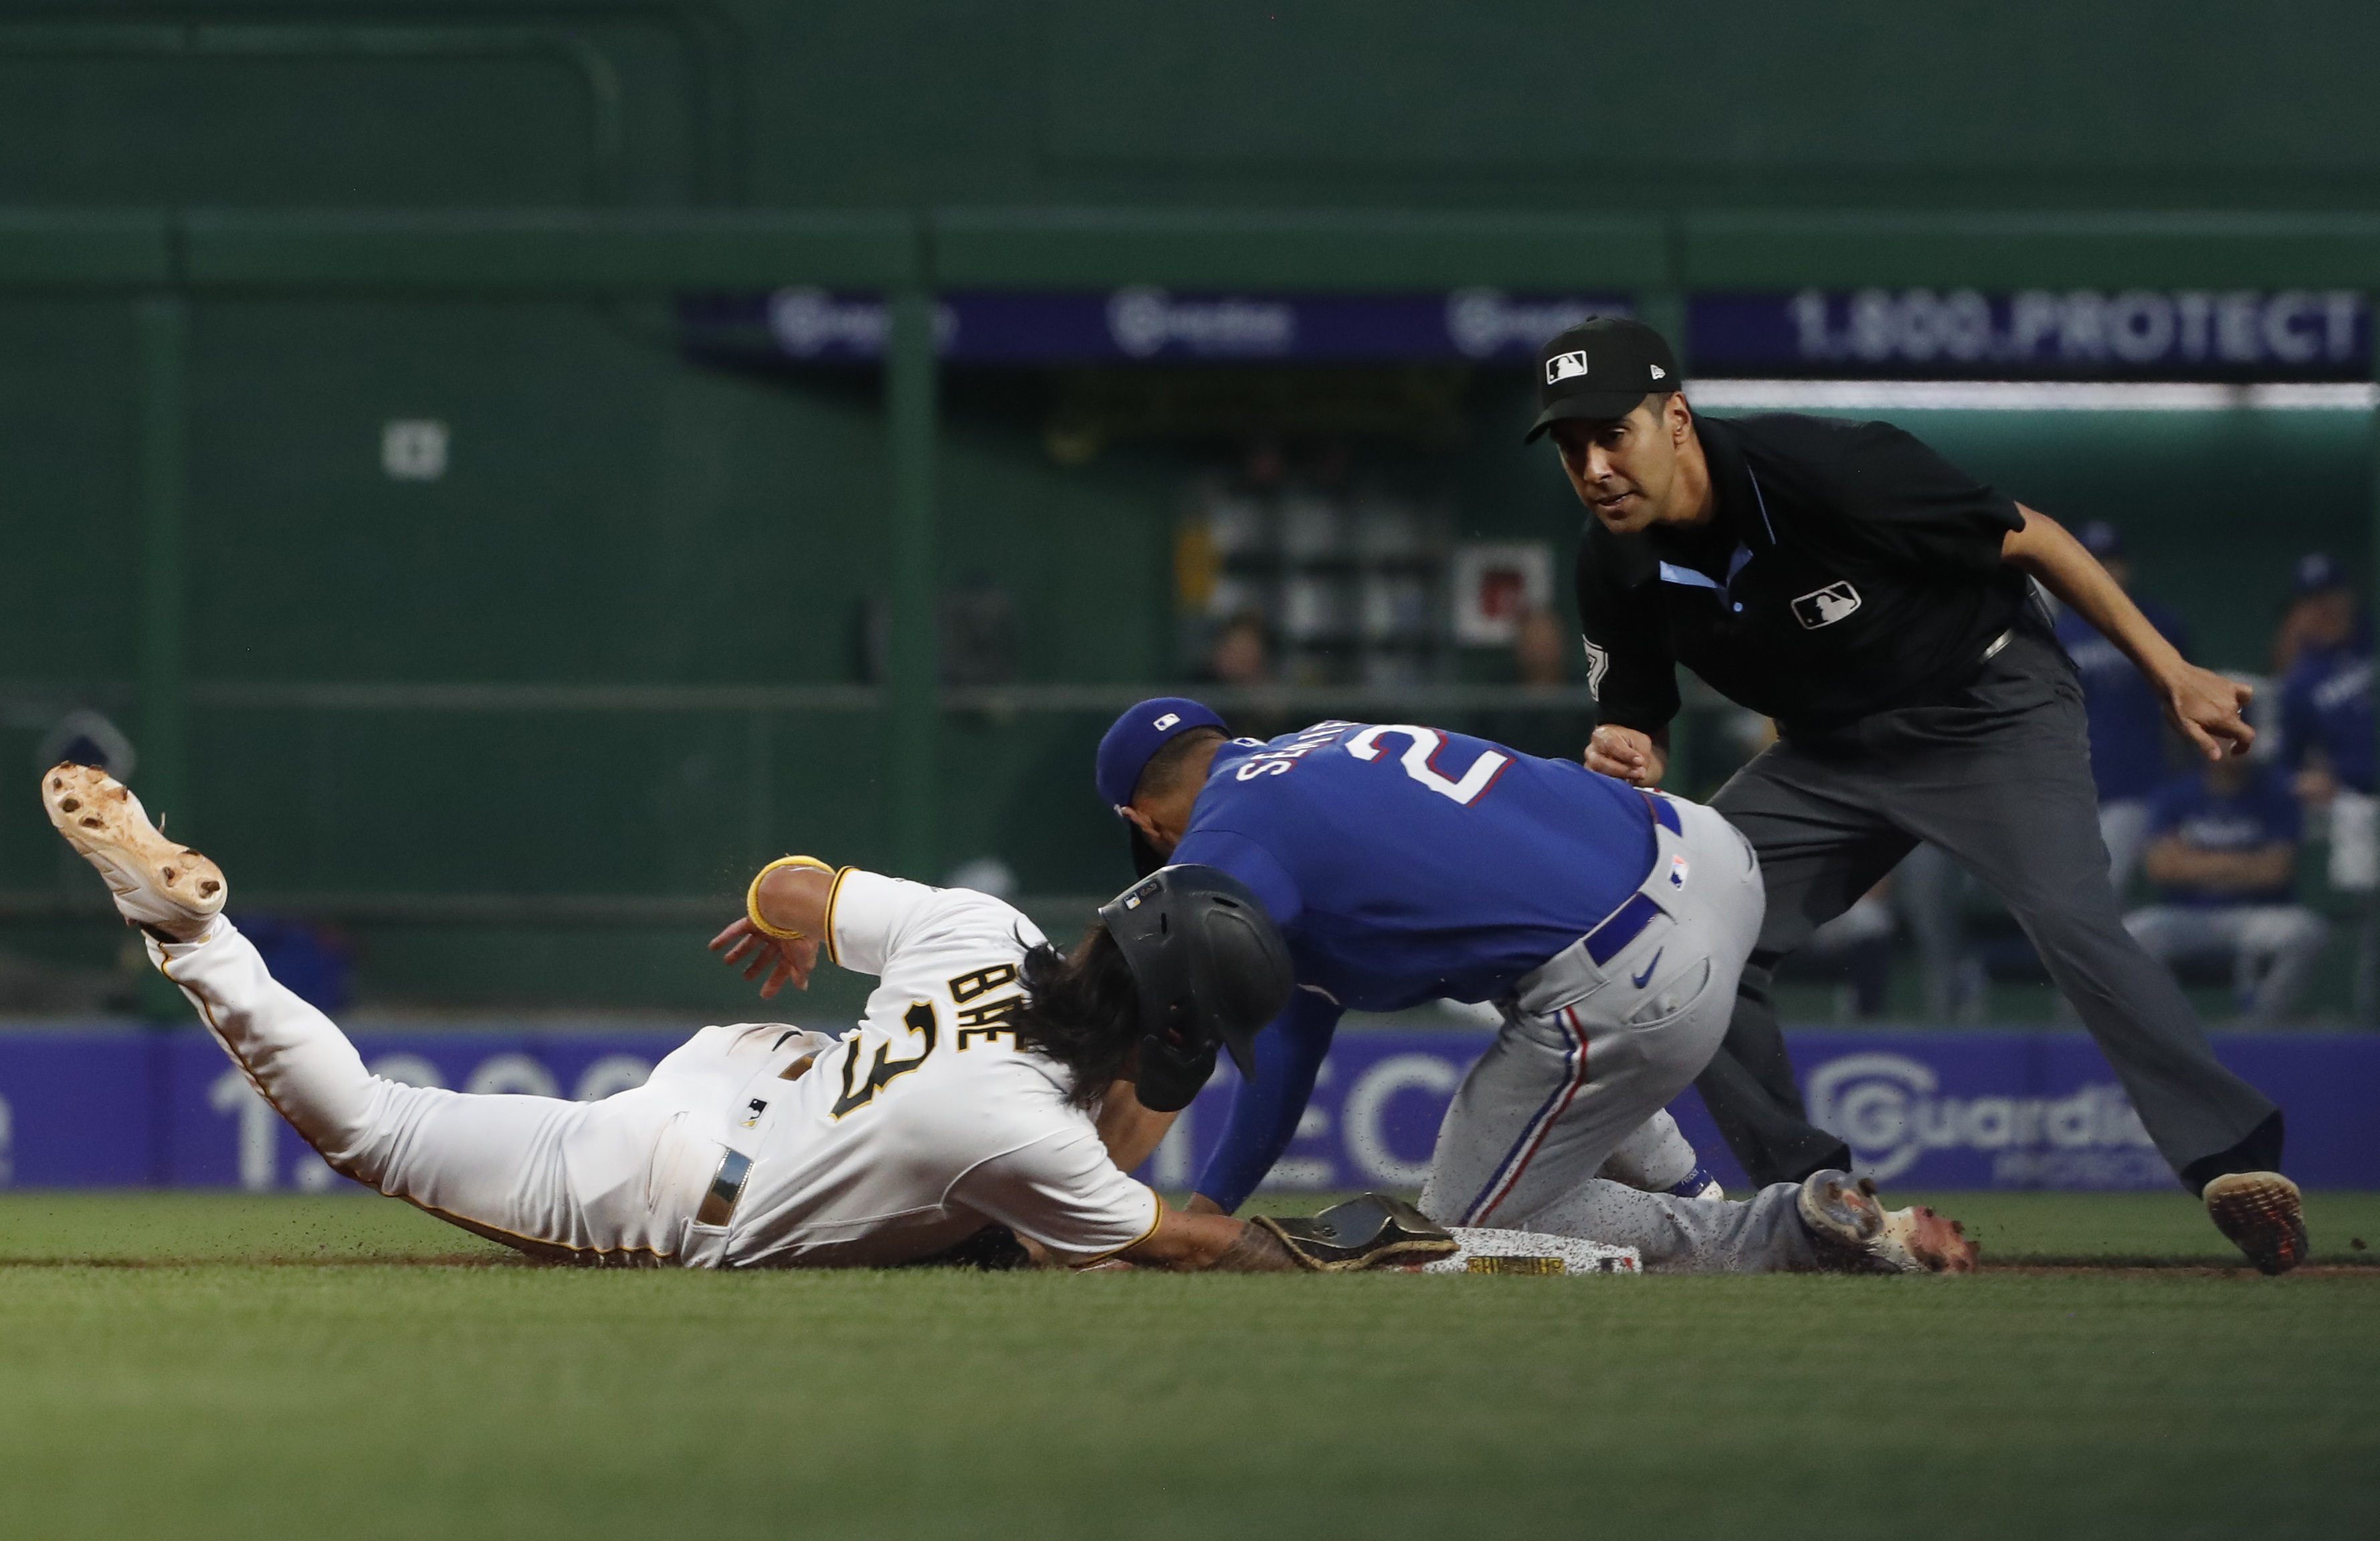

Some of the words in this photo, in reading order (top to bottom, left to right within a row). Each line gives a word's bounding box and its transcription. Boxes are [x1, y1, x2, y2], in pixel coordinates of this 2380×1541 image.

[1345, 724, 1517, 807] 2
[947, 962, 1023, 1053] BAE
[827, 999, 938, 1123] 3
